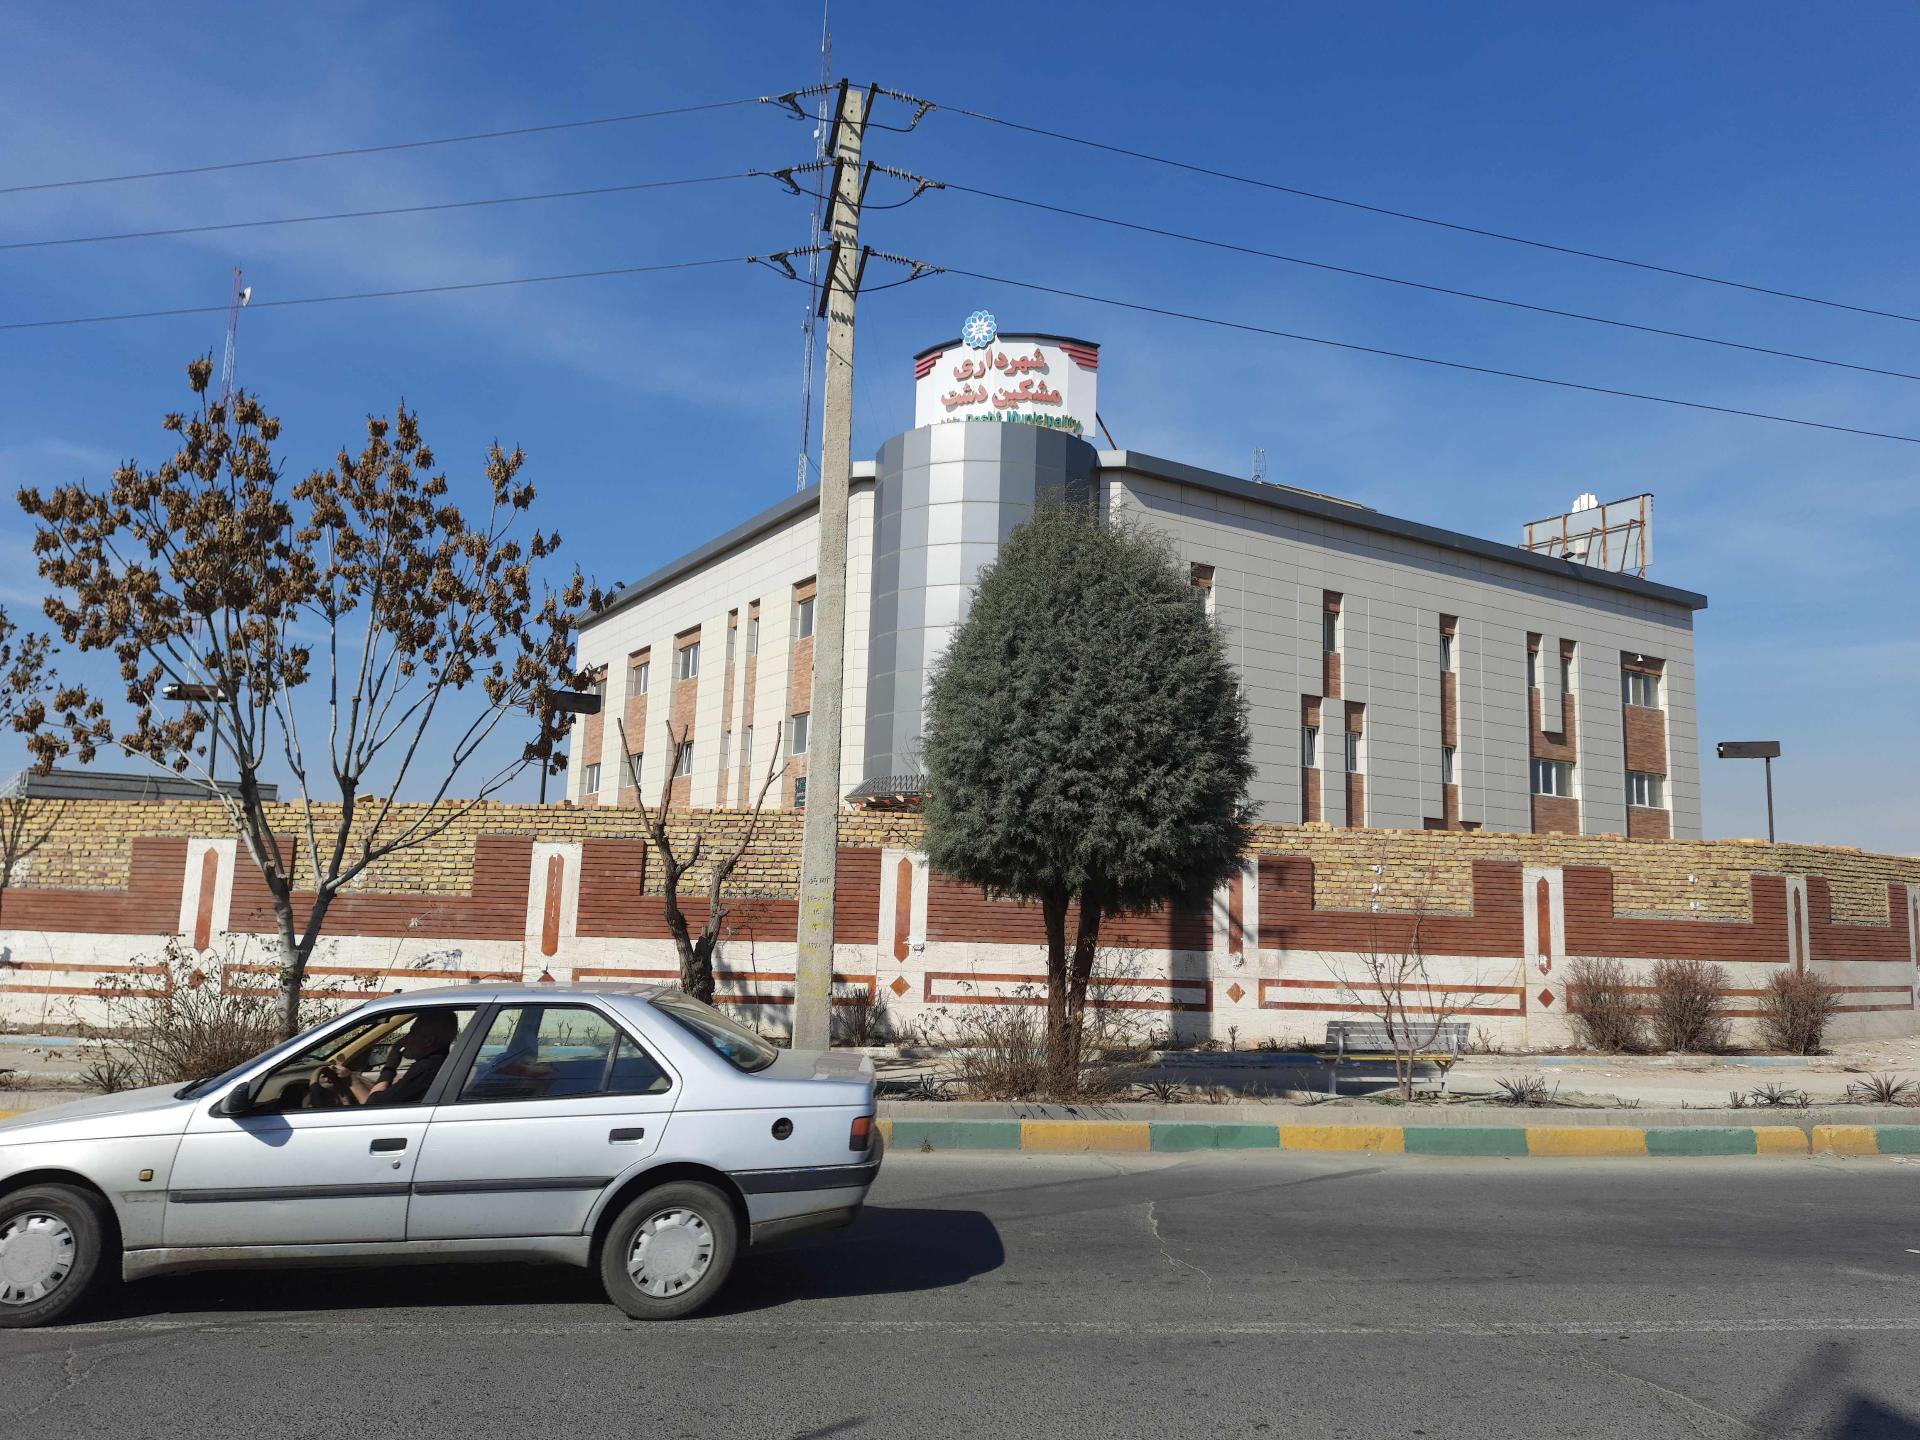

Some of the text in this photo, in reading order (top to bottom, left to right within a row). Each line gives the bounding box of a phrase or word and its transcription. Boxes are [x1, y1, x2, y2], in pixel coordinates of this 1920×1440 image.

[953, 347, 1045, 379] شهرداری
[941, 378, 1063, 409] مشکین دشت
[1006, 410, 1082, 433] Municipality
